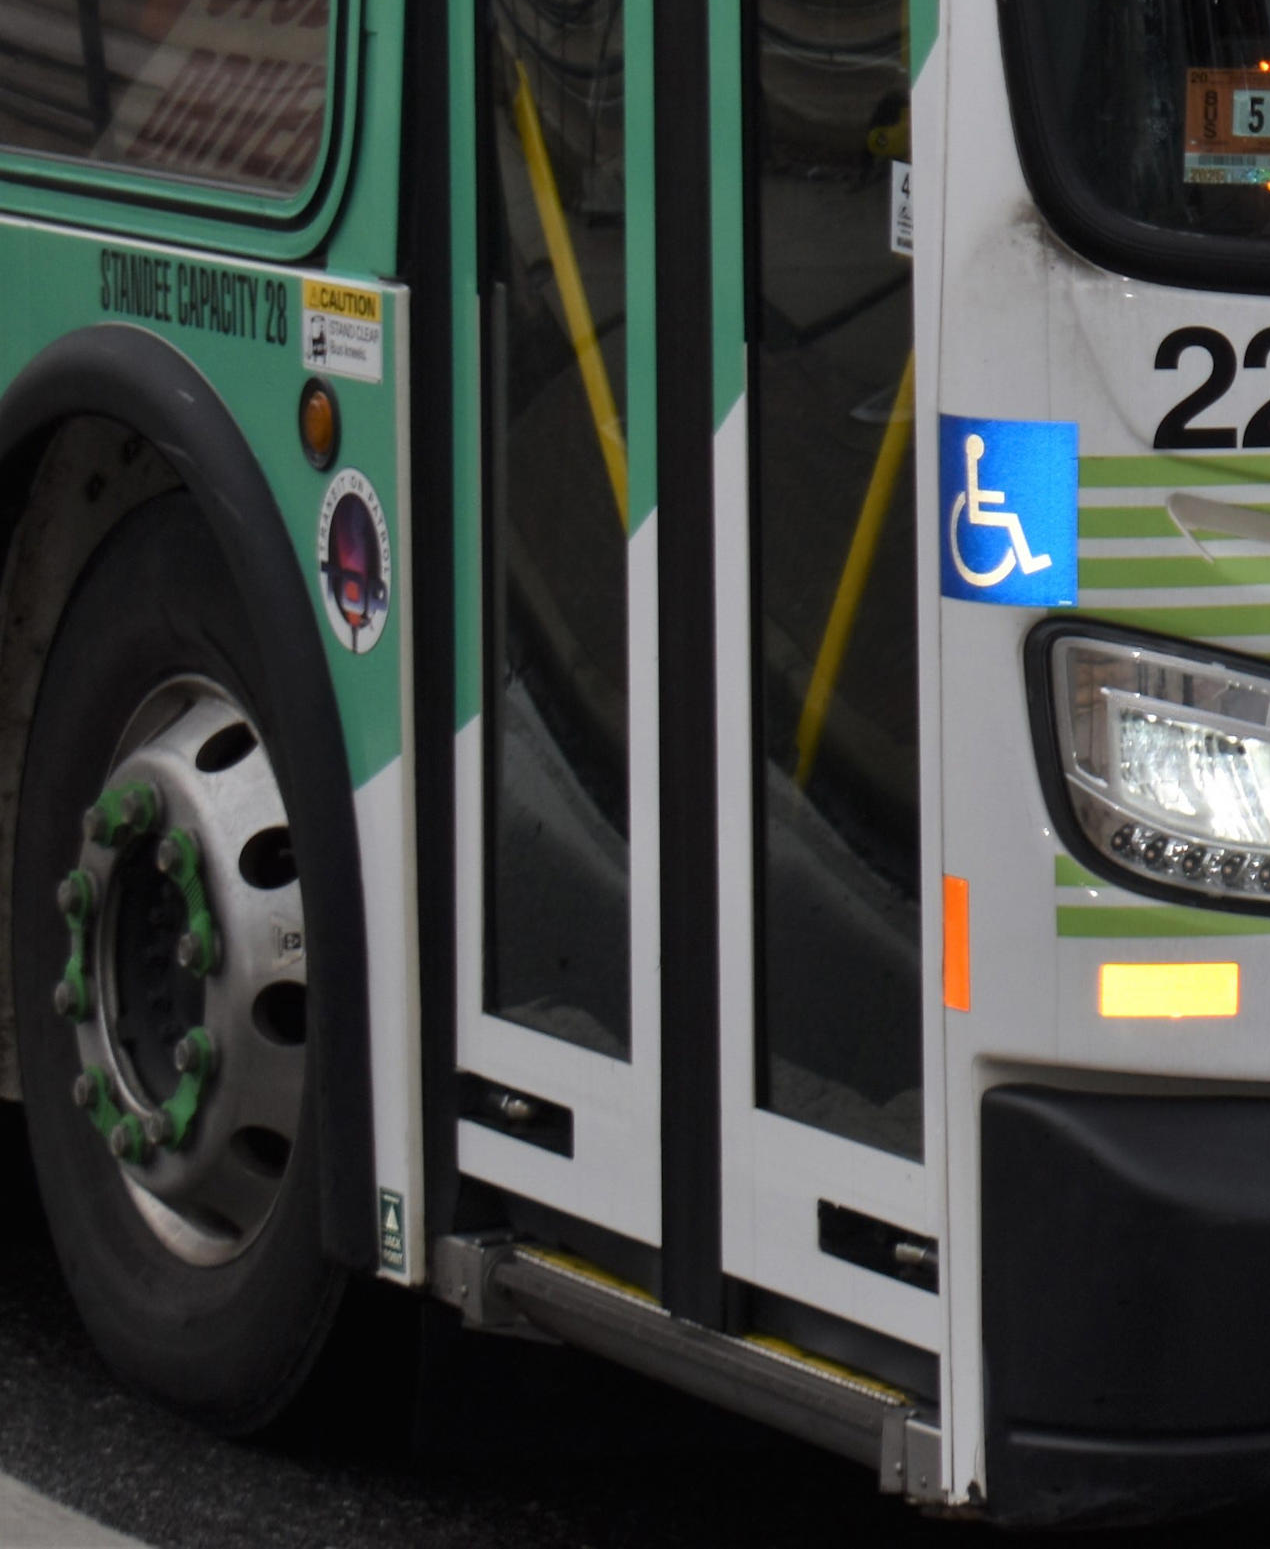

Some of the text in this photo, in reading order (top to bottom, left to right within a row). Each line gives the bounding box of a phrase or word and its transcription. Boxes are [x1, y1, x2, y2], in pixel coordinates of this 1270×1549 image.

[1203, 90, 1218, 139] BUS
[1248, 97, 1265, 134] 5
[101, 248, 288, 346] STANDEE CAPACITY 28
[320, 286, 376, 318] CAUTION
